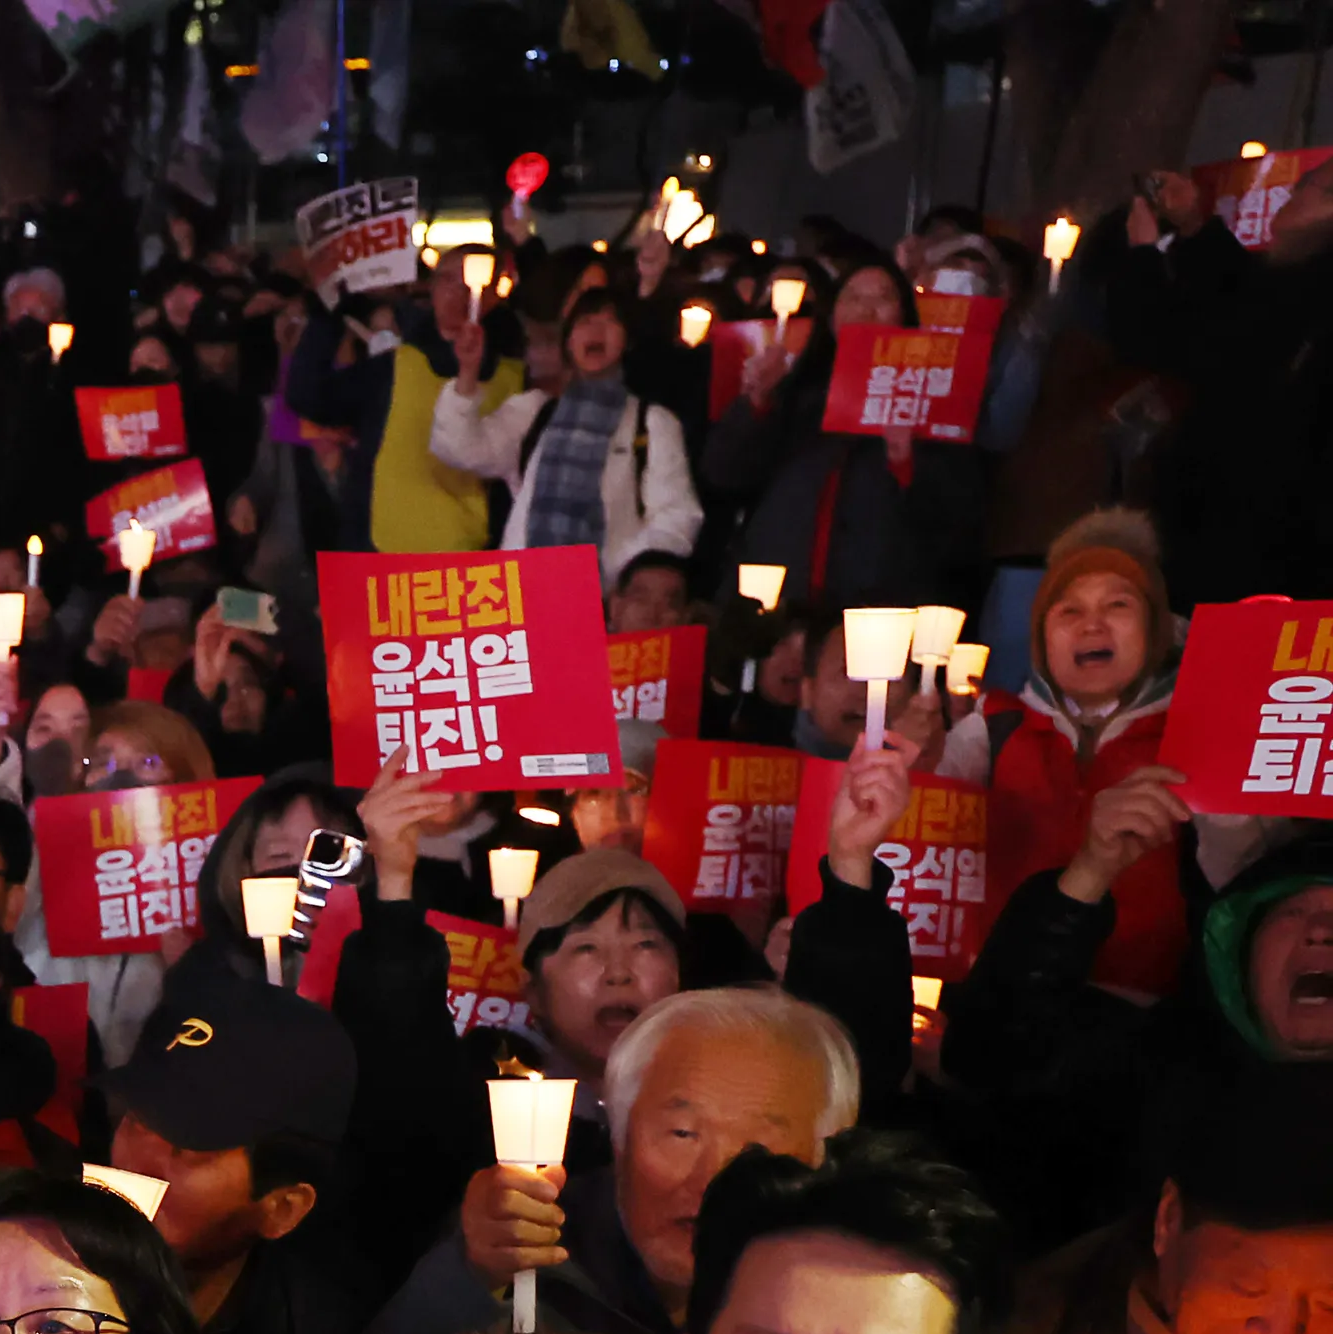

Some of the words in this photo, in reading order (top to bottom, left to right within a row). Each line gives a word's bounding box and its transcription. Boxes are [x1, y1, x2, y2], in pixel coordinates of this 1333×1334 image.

[367, 561, 524, 636] 내란죄
[372, 630, 532, 708] 윤석열
[612, 679, 667, 722] 석열
[377, 706, 503, 773] 퇴진!
[89, 788, 217, 850] 내란죄
[95, 834, 217, 896] 윤석열
[100, 893, 197, 940] 퇴진!
[891, 902, 965, 958] 진!
